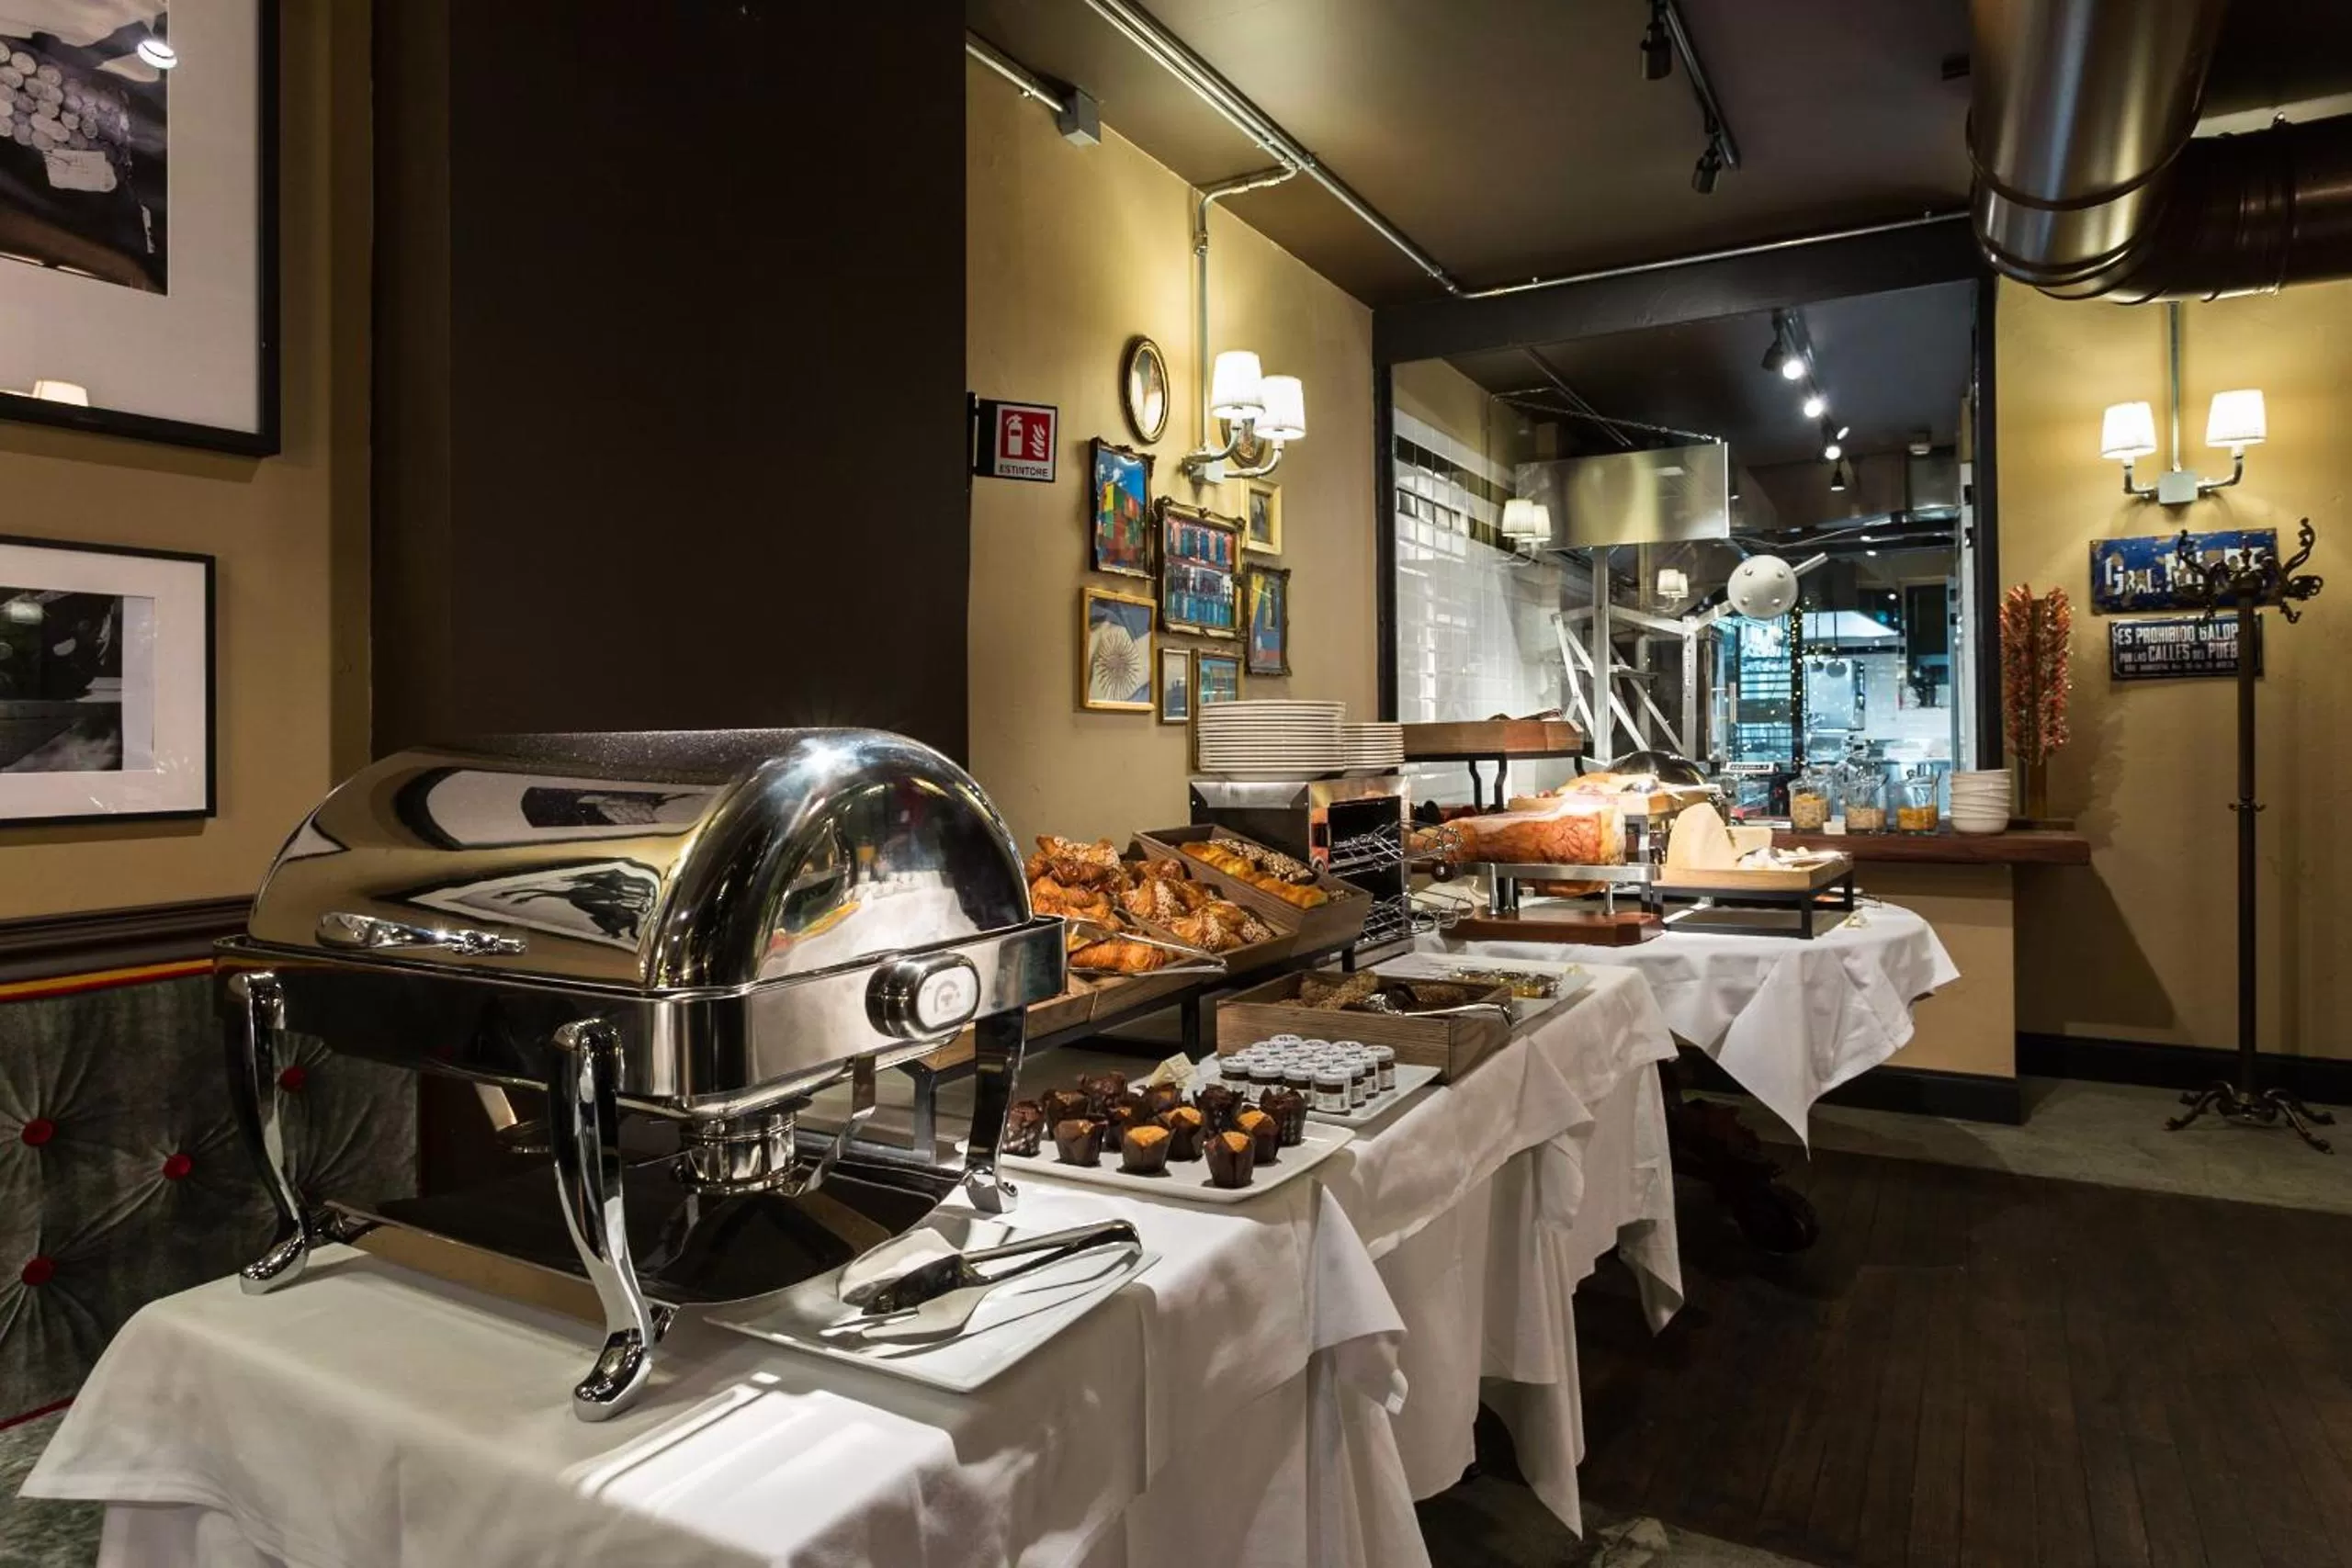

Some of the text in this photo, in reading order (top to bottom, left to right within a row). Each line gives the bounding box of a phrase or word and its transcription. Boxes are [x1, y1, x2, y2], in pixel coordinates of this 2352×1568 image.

[999, 463, 1049, 478] ESTINTORE
[2117, 623, 2239, 645] ES PROHIBIDO GALOP
[2147, 643, 2190, 662] CALLES
[2208, 641, 2239, 660] PUEB
